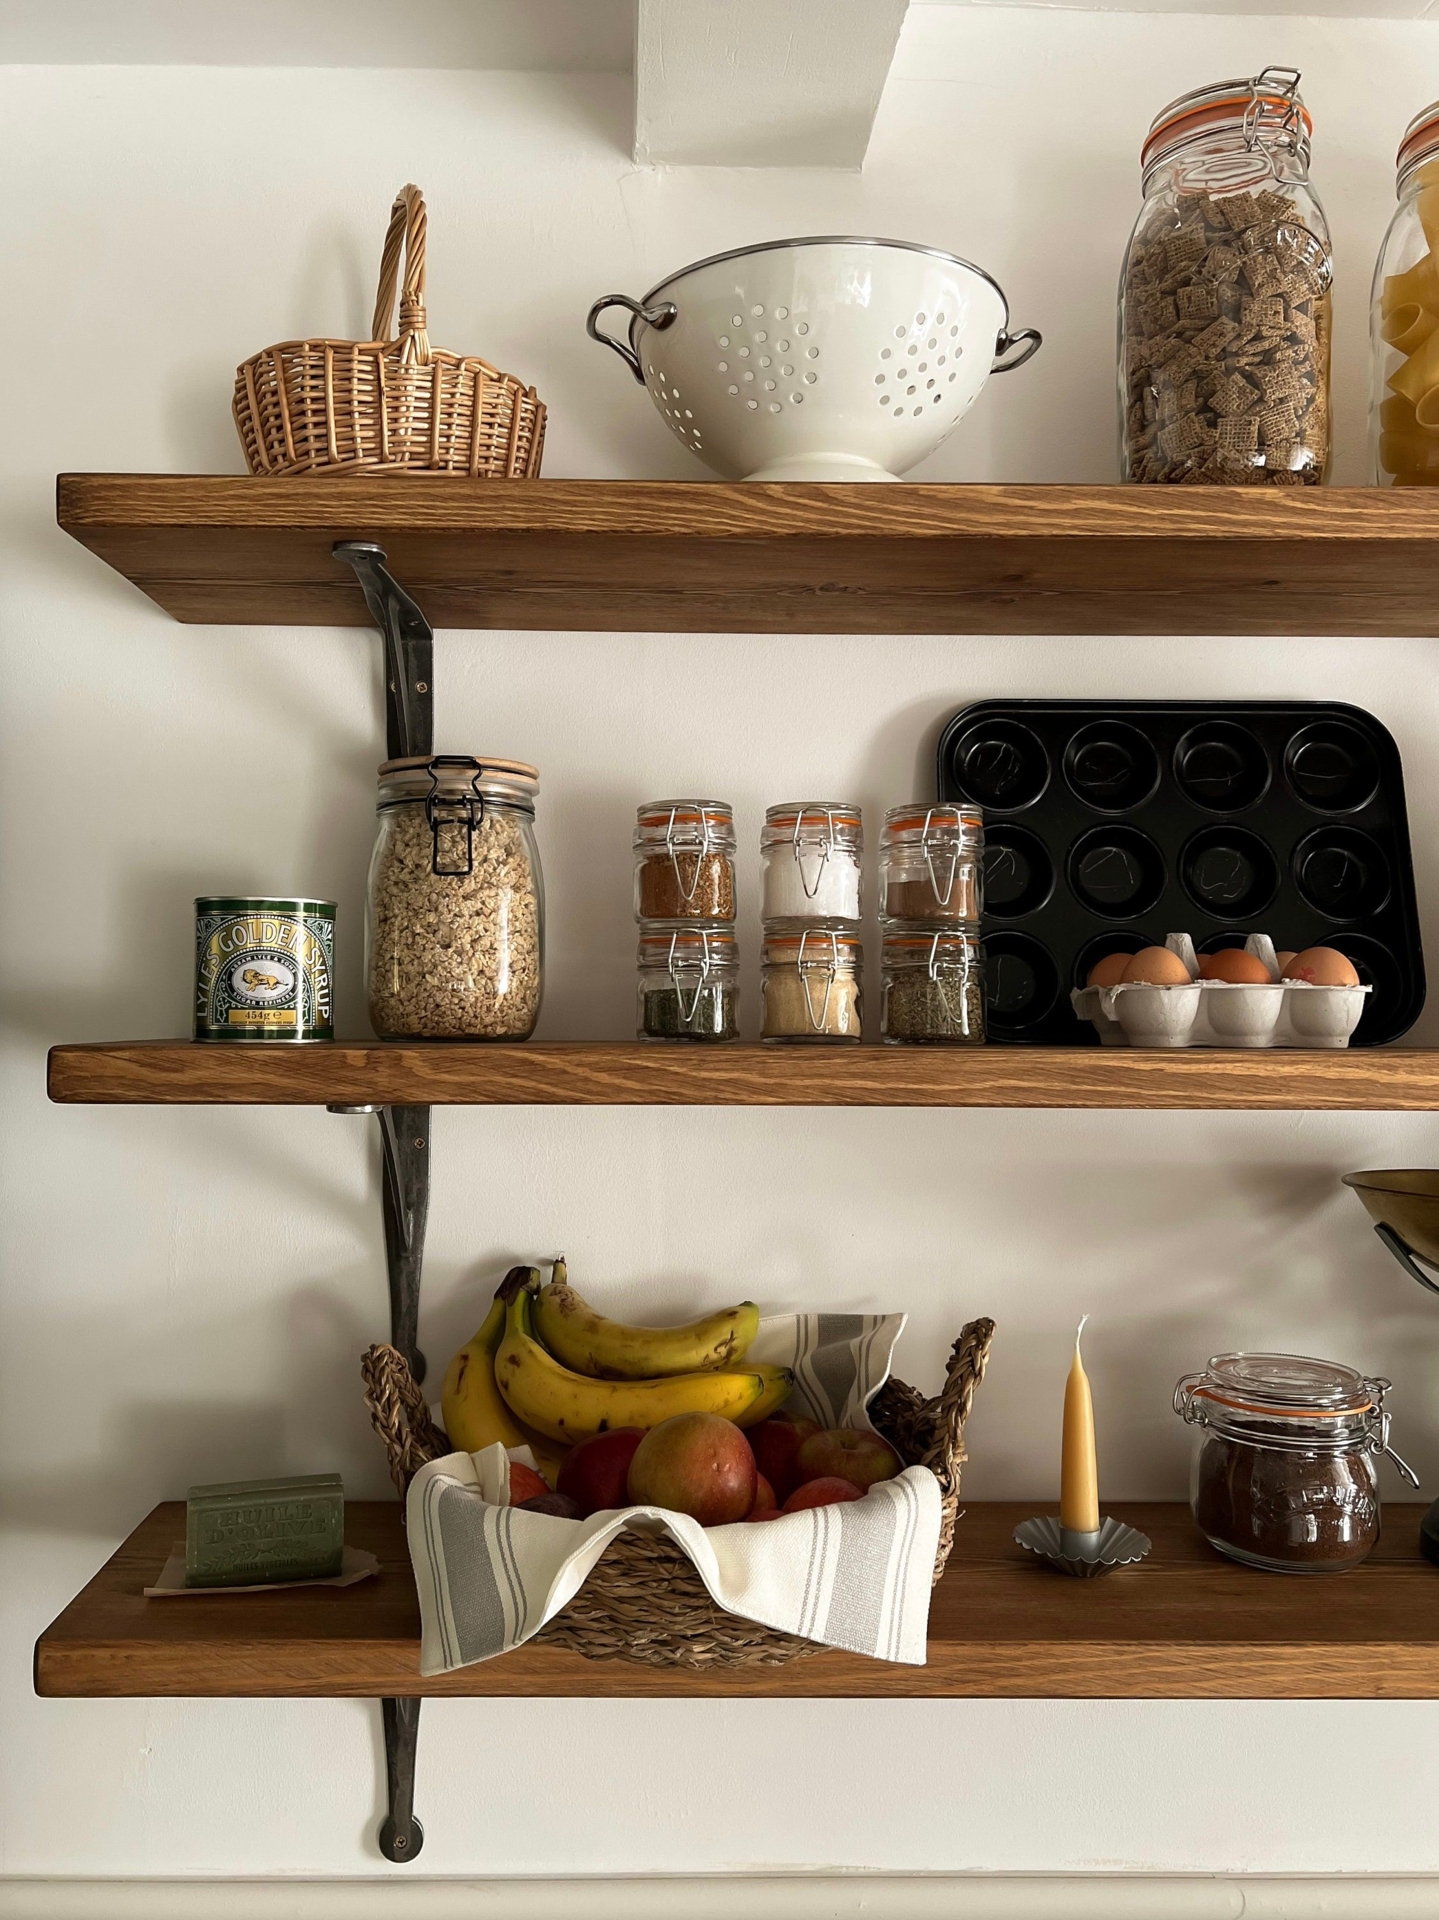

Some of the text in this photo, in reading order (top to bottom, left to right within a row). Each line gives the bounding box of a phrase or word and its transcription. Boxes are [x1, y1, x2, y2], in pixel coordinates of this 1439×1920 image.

[197, 921, 329, 1019] LYLE'S GOLDEN SYRUP
[231, 956, 251, 972] ABRAM
[280, 958, 296, 973] SONS
[233, 991, 256, 1005] SUGAR
[259, 991, 293, 1006] REFINERS
[245, 1011, 271, 1020] 454g
[218, 1503, 313, 1527] HUILE
[204, 1517, 327, 1545] D'OLIVE
[232, 1561, 259, 1572] HUILES
